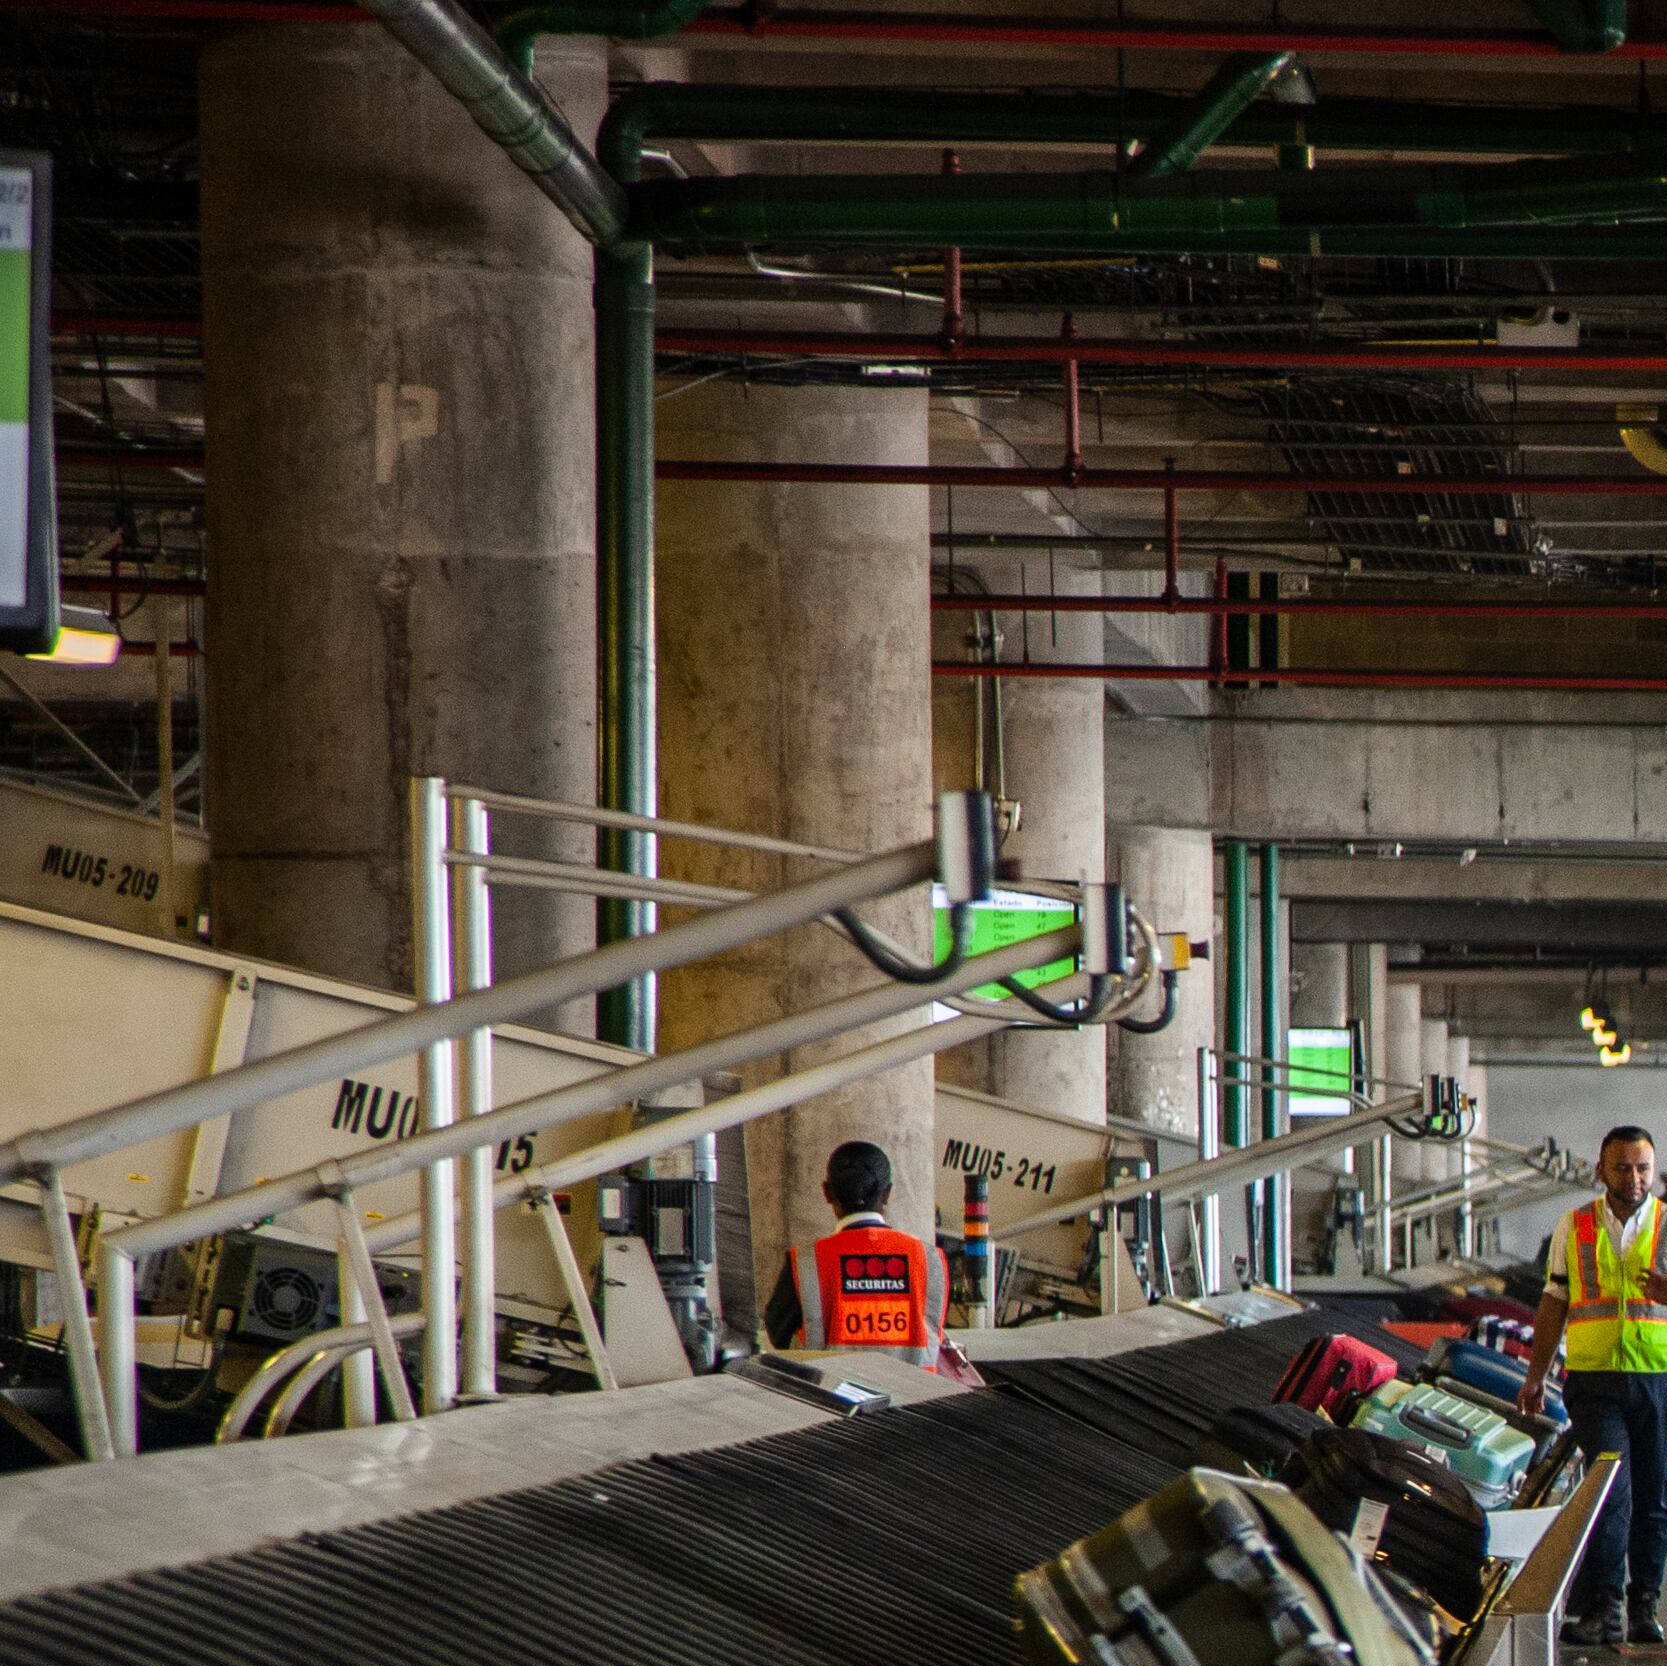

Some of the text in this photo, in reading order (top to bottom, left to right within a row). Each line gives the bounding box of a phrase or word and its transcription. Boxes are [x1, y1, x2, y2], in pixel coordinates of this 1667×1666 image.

[42, 843, 160, 901] MU05-209
[942, 1138, 1057, 1195] MU05-211
[846, 1279, 905, 1291] SECURITAS
[845, 1311, 907, 1334] 0156
